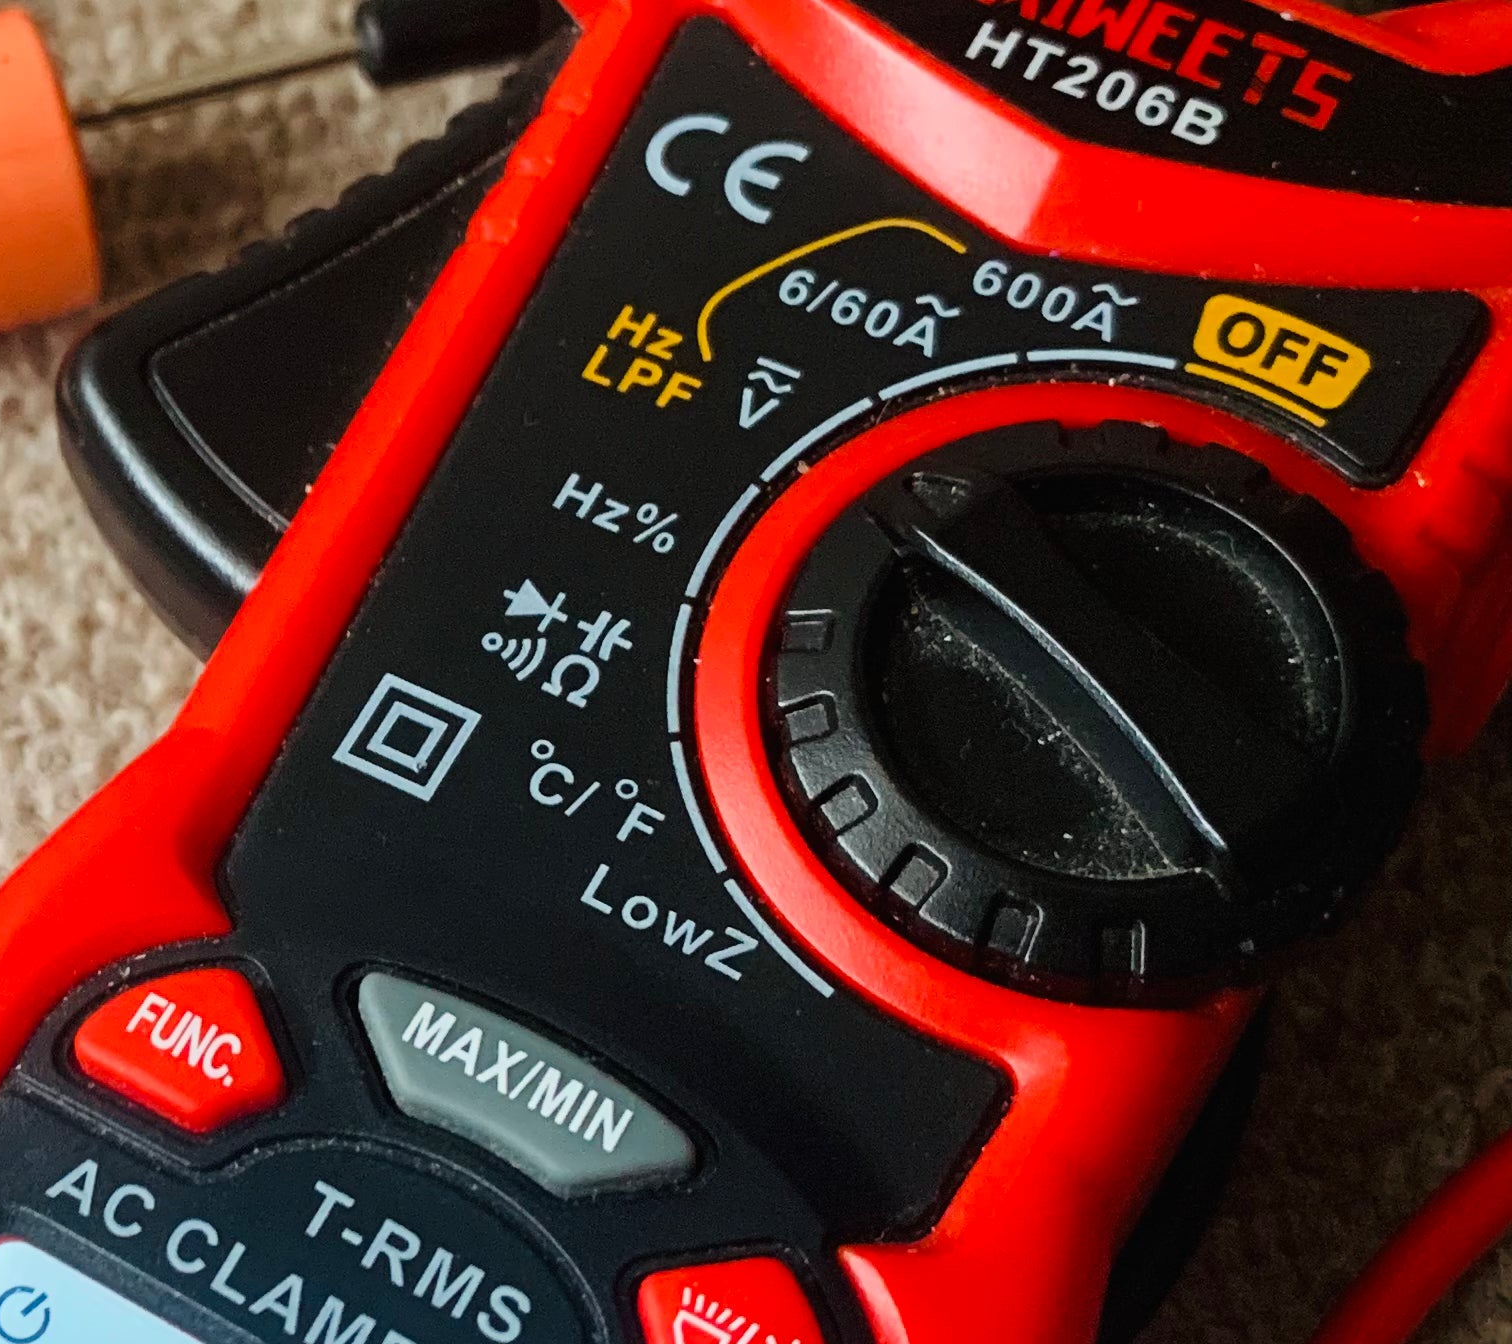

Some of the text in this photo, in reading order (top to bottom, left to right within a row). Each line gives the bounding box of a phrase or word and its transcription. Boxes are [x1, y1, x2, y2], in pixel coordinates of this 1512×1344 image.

[965, 20, 1226, 145] HT206B
[582, 345, 702, 409] LPF
[606, 305, 684, 360] Hz
[1216, 311, 1349, 390] OFF
[552, 473, 676, 554] Hz%
[580, 863, 760, 981] LowZ
[125, 990, 243, 1088] FUNC.
[402, 1000, 634, 1154] MAX/MIN
[45, 1158, 155, 1237] AC
[304, 1179, 532, 1344] T-RMS
